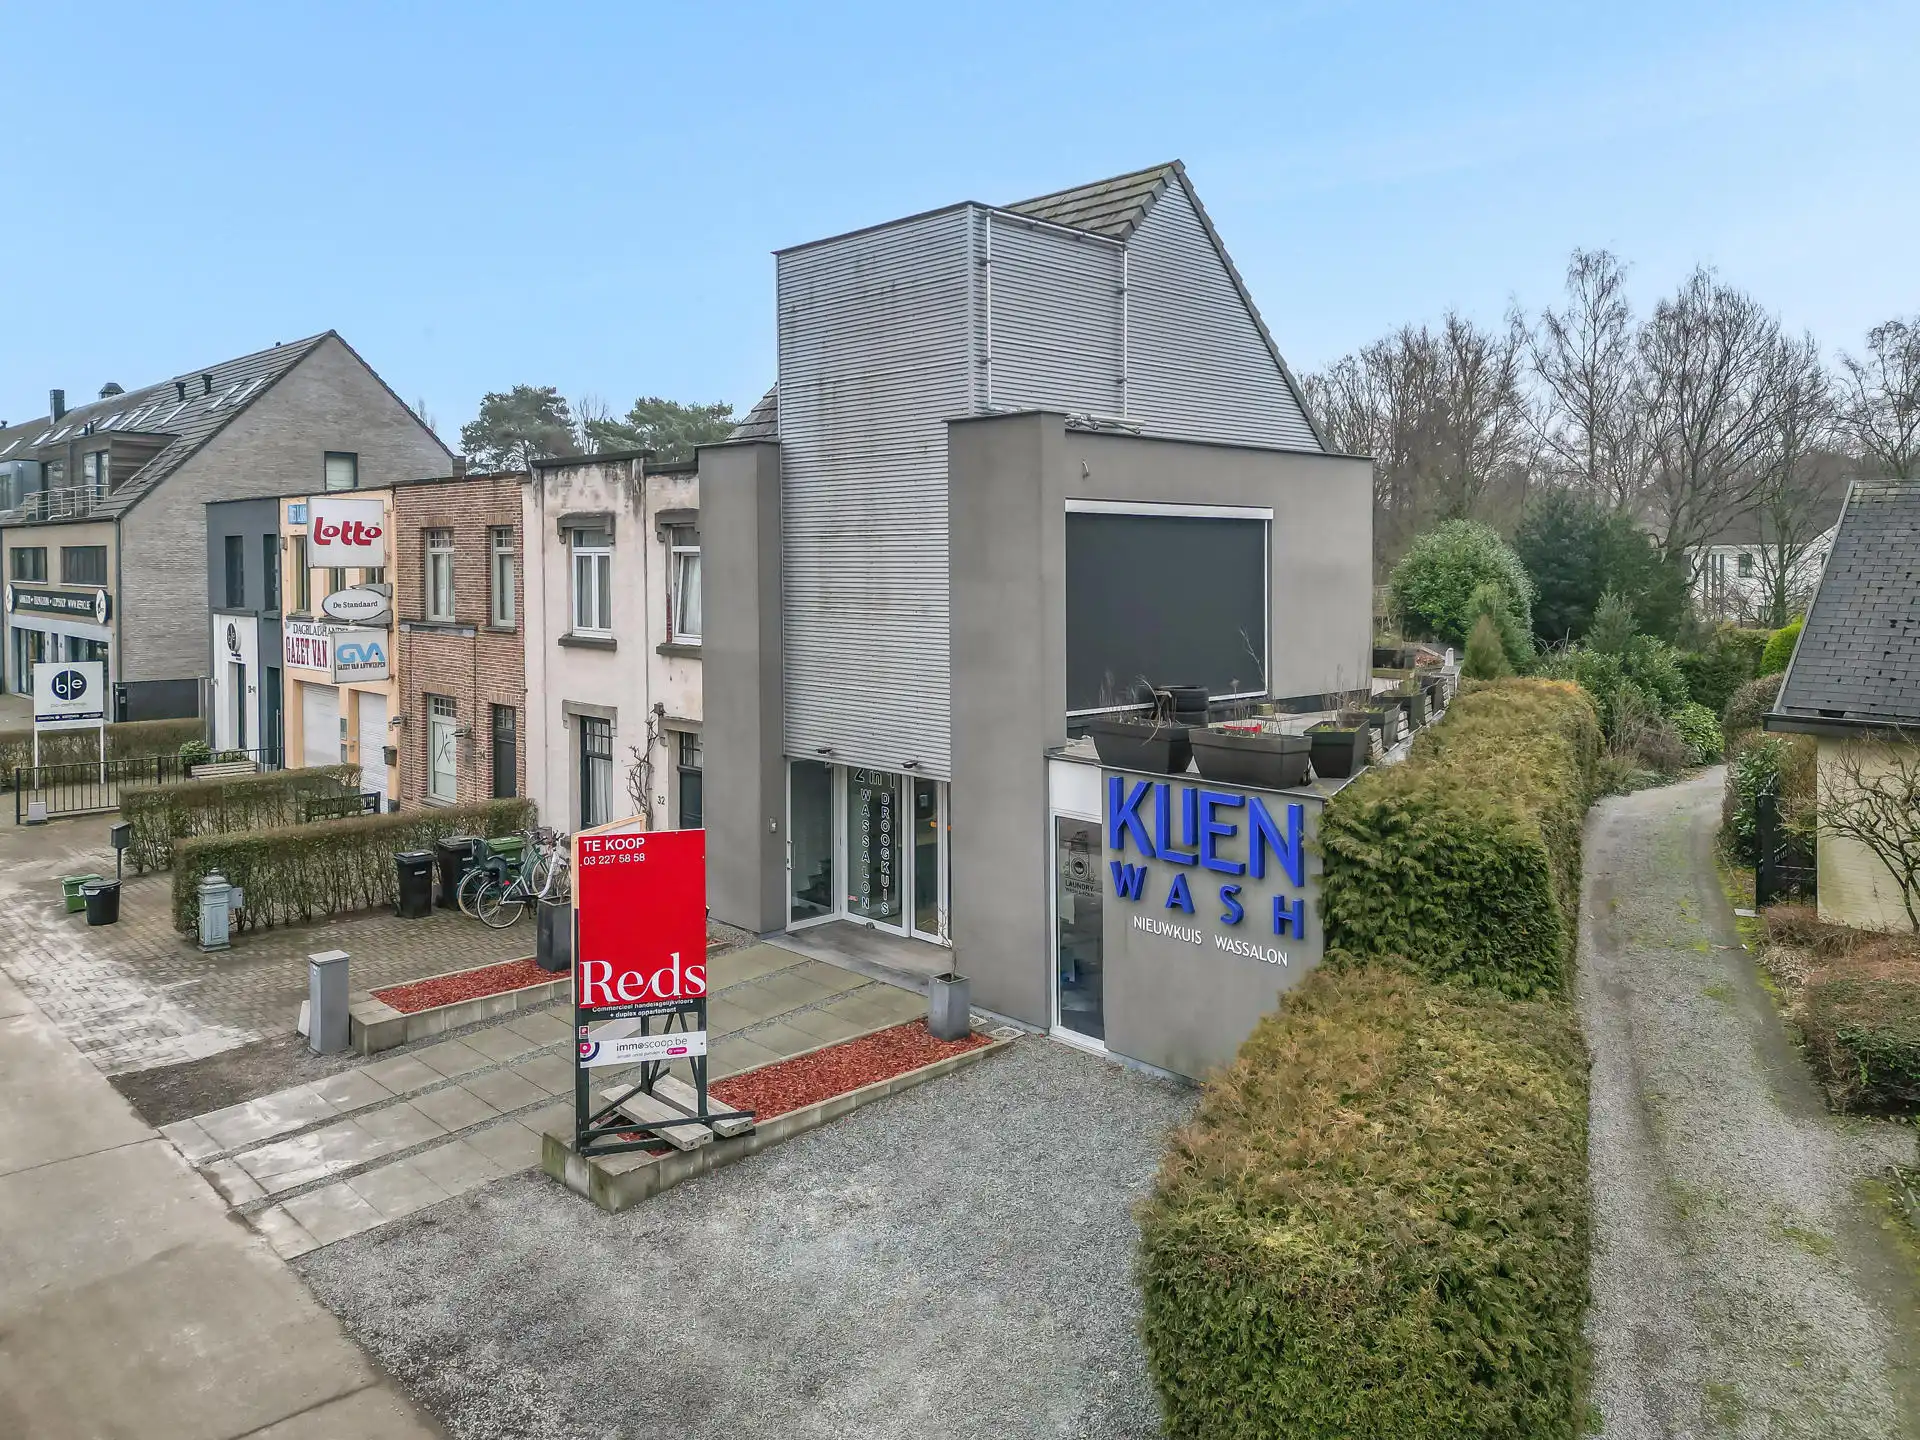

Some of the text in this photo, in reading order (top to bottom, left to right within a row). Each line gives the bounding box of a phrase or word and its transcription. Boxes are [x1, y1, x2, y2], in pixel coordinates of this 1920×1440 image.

[314, 517, 382, 545] Lotto
[343, 600, 378, 608] Standaard
[286, 636, 327, 668] GAZET VAN
[337, 642, 385, 663] GVA
[657, 795, 665, 805] 32
[584, 837, 645, 852] TE KOOP
[861, 788, 871, 910] WASSALON
[880, 792, 890, 915] DROOGKUIS
[584, 853, 645, 866] 03 227 58 58
[1065, 880, 1094, 892] LAUNDRY
[1110, 860, 1304, 940] WASH
[1133, 915, 1288, 966] NIEUWKUIS WASSALON
[580, 952, 706, 1005] Reds
[592, 1003, 633, 1012] Commercieel
[637, 1006, 677, 1017] appartement
[616, 1037, 688, 1051] immoscoop.be
